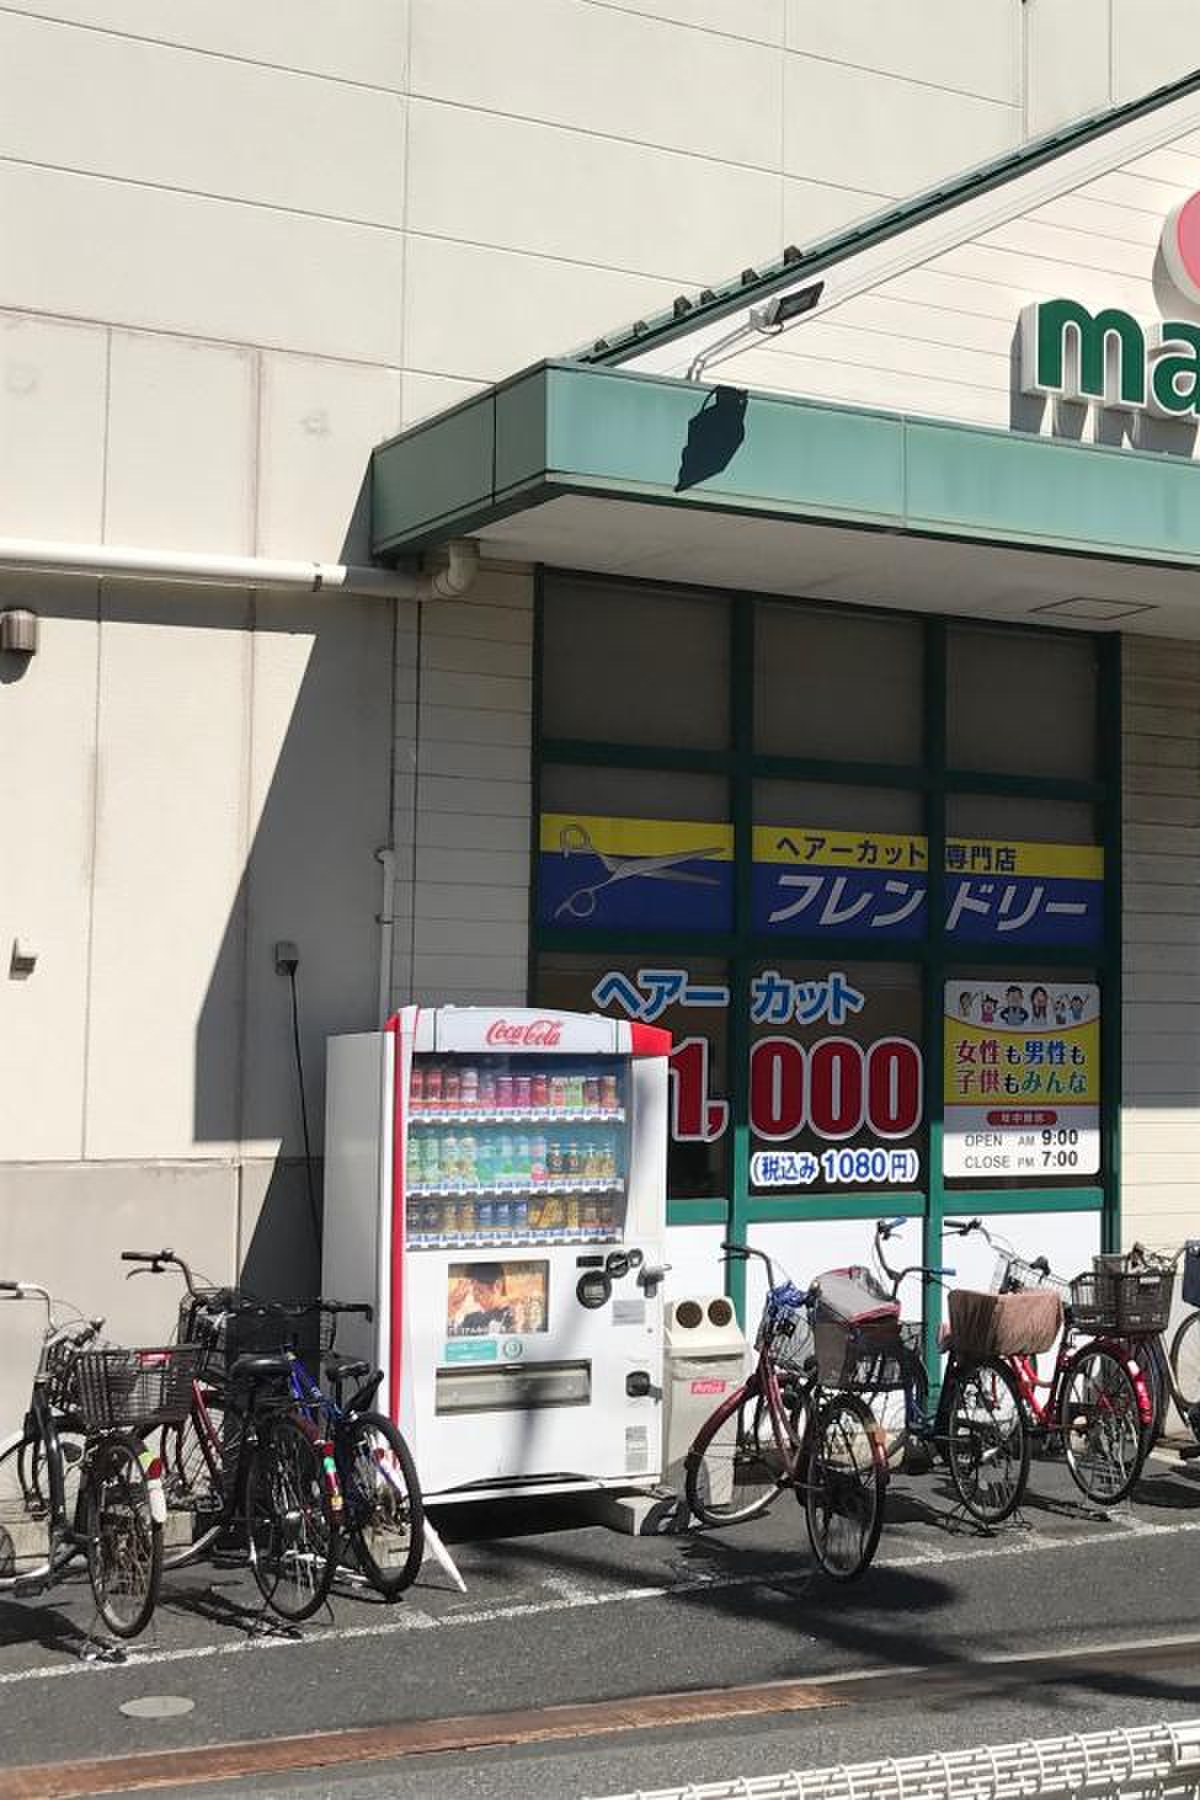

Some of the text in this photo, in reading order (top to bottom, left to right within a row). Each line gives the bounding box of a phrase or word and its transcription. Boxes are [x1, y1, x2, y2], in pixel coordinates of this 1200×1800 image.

[767, 873, 1089, 931] フレンドリー
[956, 1039, 1086, 1065] 女性も男性も
[668, 1036, 923, 1143] 1,000
[956, 1069, 1088, 1094] 子供もみんな
[964, 1134, 1003, 1147] OPEN
[1041, 1128, 1079, 1146] 9:00
[964, 1155, 1011, 1169] CLOSE
[1041, 1150, 1079, 1167] 7:00
